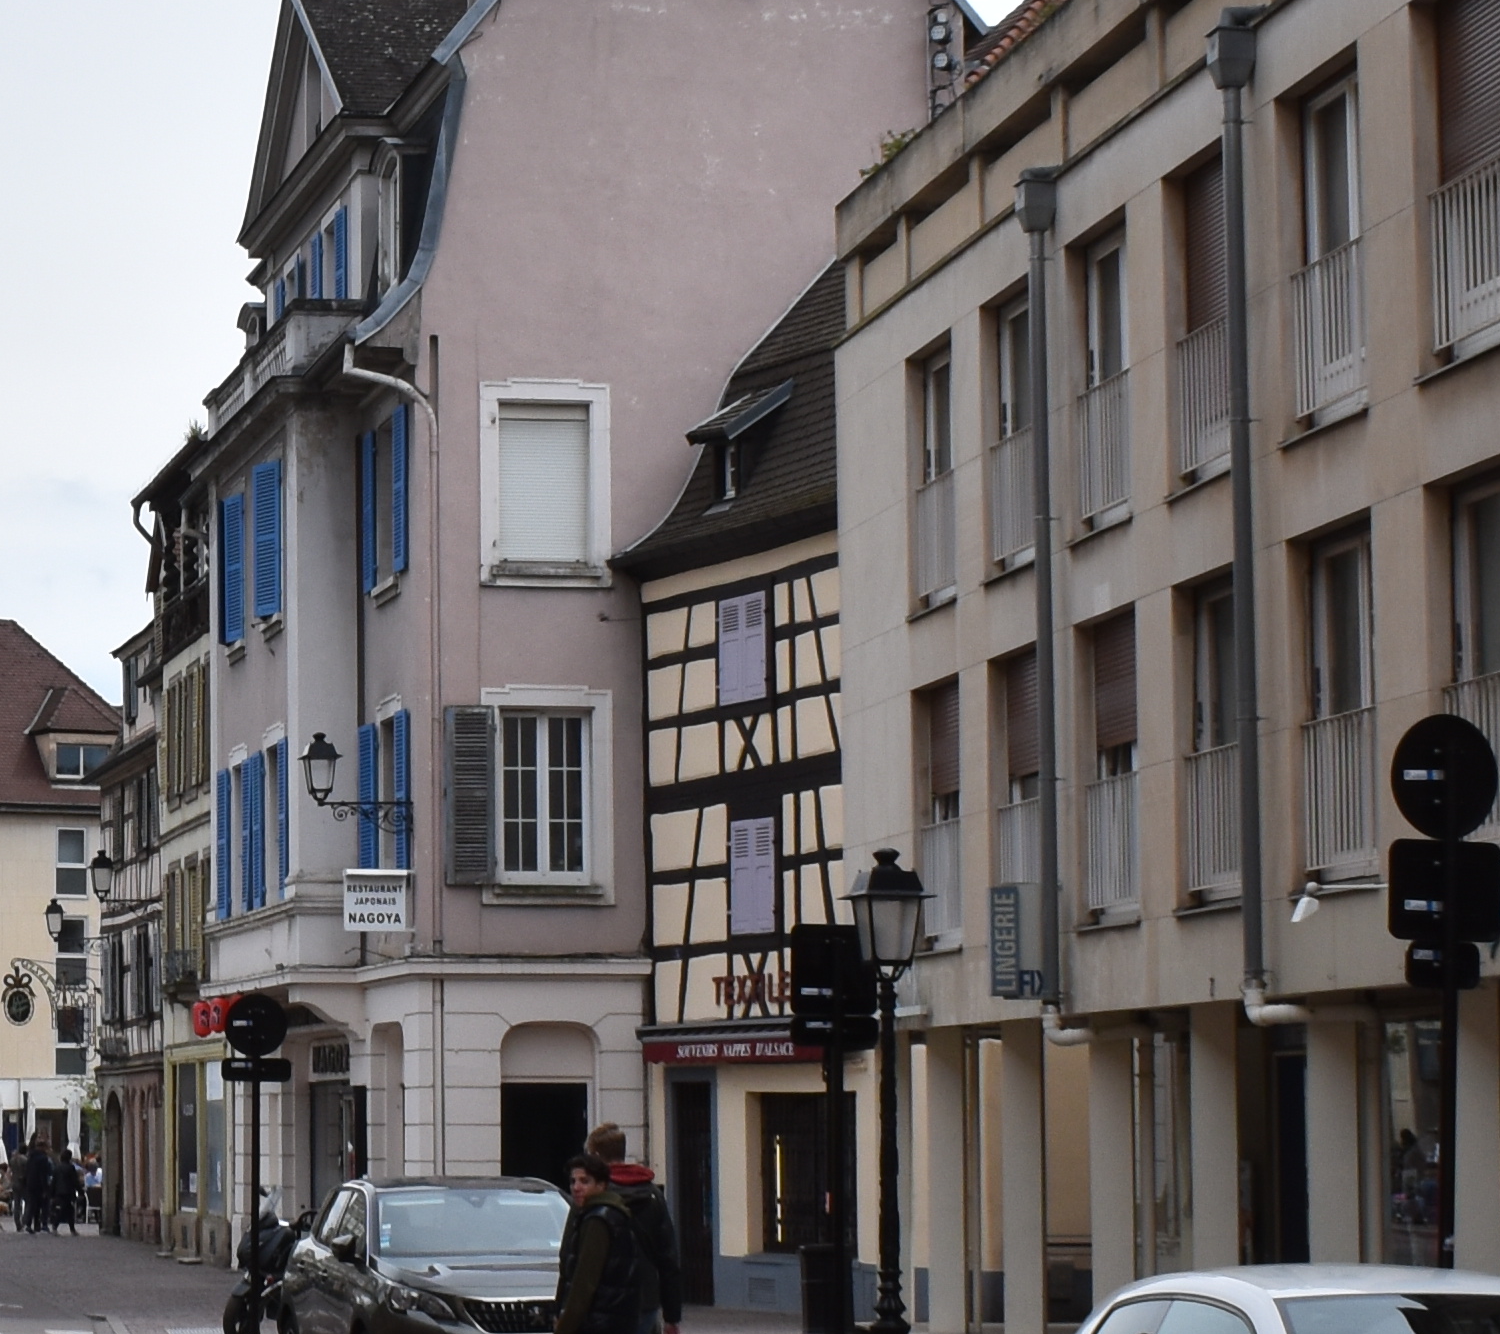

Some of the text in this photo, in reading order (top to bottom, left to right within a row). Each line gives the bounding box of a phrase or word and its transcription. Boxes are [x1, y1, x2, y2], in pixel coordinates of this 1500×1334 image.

[347, 884, 403, 893] RESTAURANT
[354, 897, 397, 906] JAPONAIS
[348, 912, 402, 924] NAGOYA
[994, 893, 1017, 992] LINGERIE
[676, 1042, 795, 1058] SOUVENIRS NAPPES D'ALSACE
